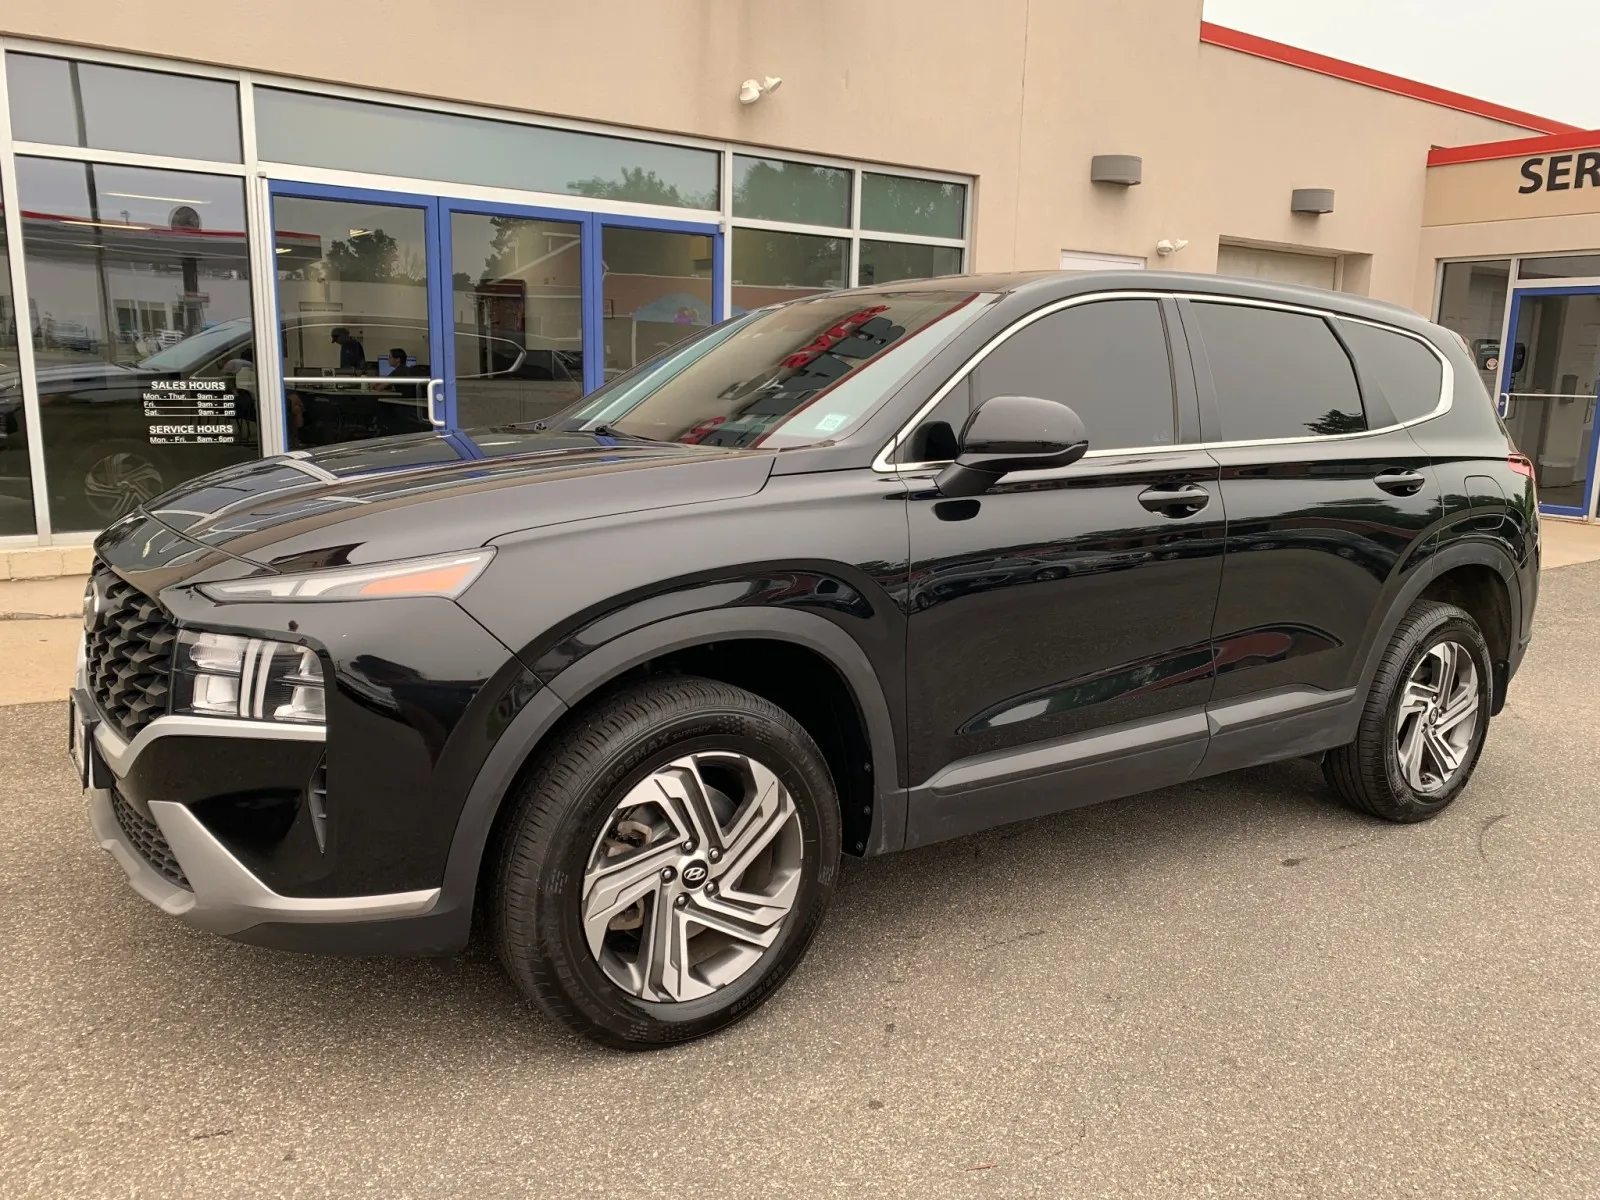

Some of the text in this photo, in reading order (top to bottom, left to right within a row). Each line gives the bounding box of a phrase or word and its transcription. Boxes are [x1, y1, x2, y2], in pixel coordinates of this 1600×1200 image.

[1518, 152, 1600, 194] SER
[151, 381, 226, 390] SALES HOURS
[149, 425, 233, 434] SERVICE HOURS
